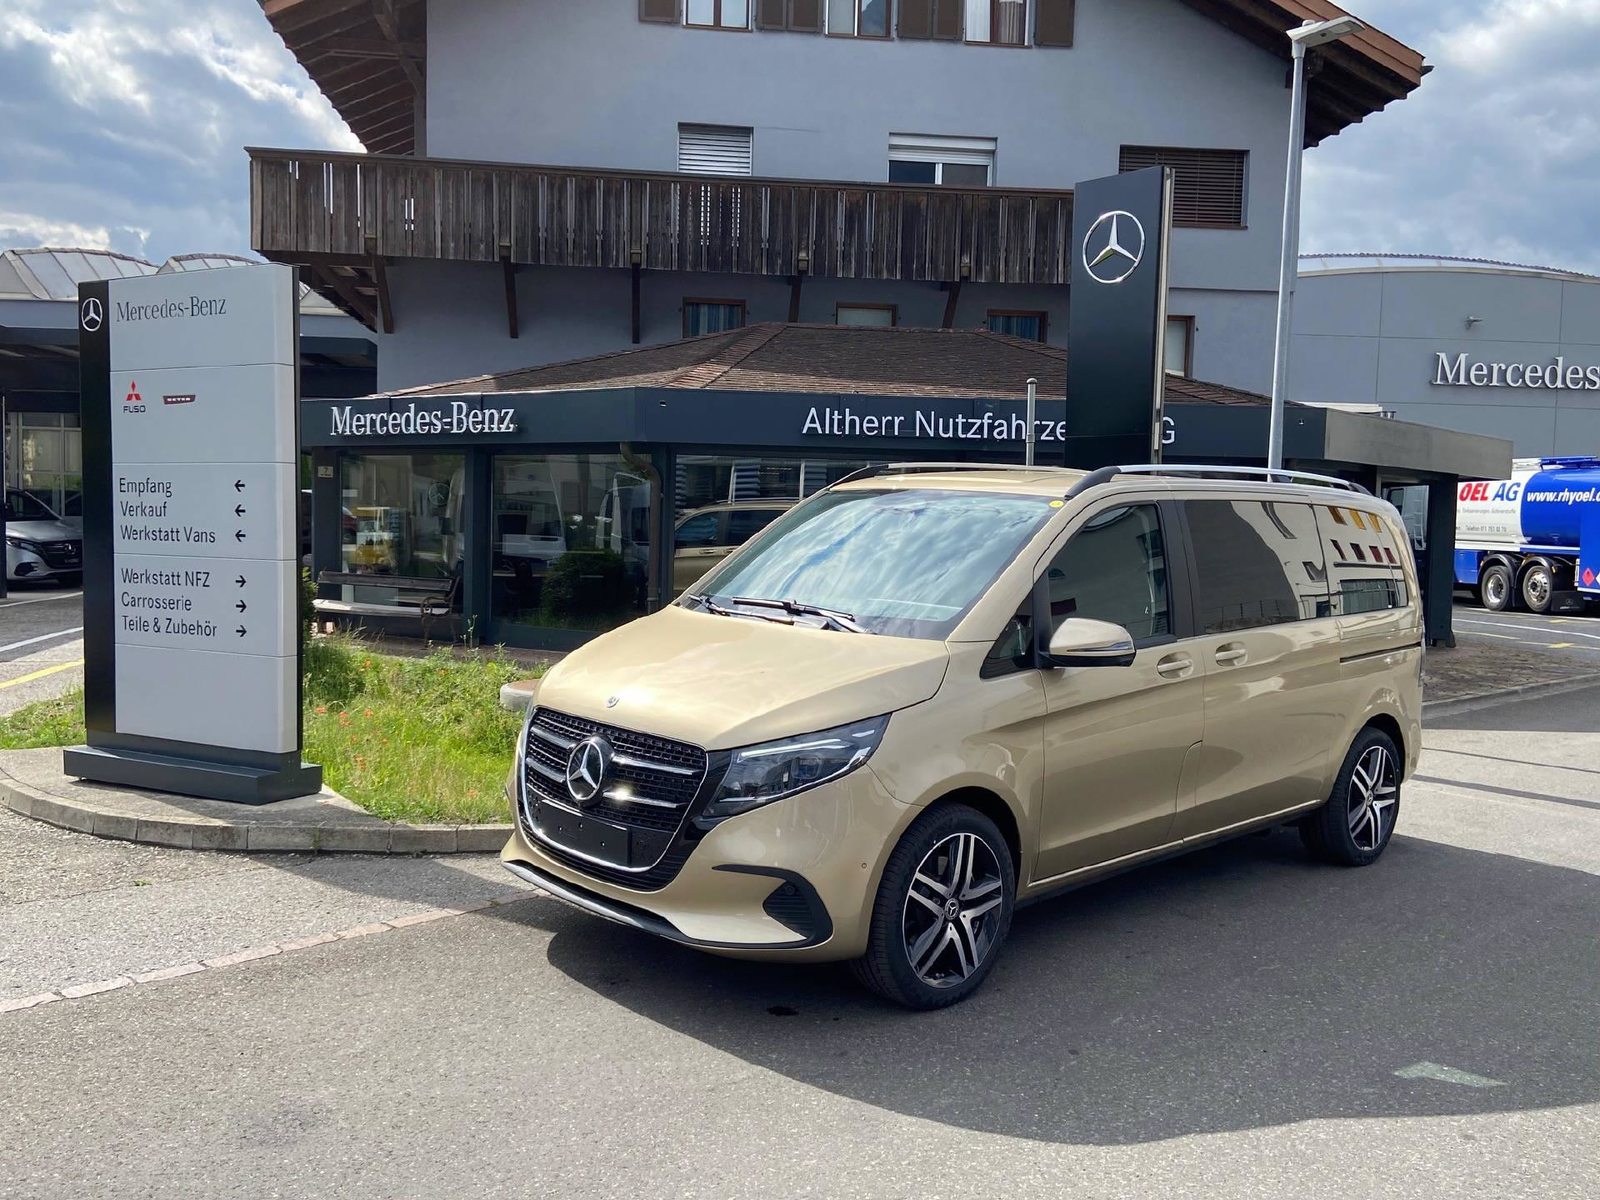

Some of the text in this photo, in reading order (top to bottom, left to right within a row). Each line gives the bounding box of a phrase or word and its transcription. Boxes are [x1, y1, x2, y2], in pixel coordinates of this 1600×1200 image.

[116, 296, 227, 322] Mercedes-Benz
[1432, 352, 1600, 389] Mercedes
[122, 405, 146, 413] FUSO
[330, 401, 515, 436] Mercedes-Benz
[802, 407, 904, 436] Altherr
[119, 477, 172, 497] Empfang
[1459, 482, 1521, 501] OEL AG
[120, 501, 167, 517] Verkauf
[120, 525, 216, 543] Werkstatt Vans
[121, 568, 210, 588] Werkstatt NFZ
[121, 592, 192, 611] Carrosserie
[122, 615, 217, 637] Teile & Zubehör
